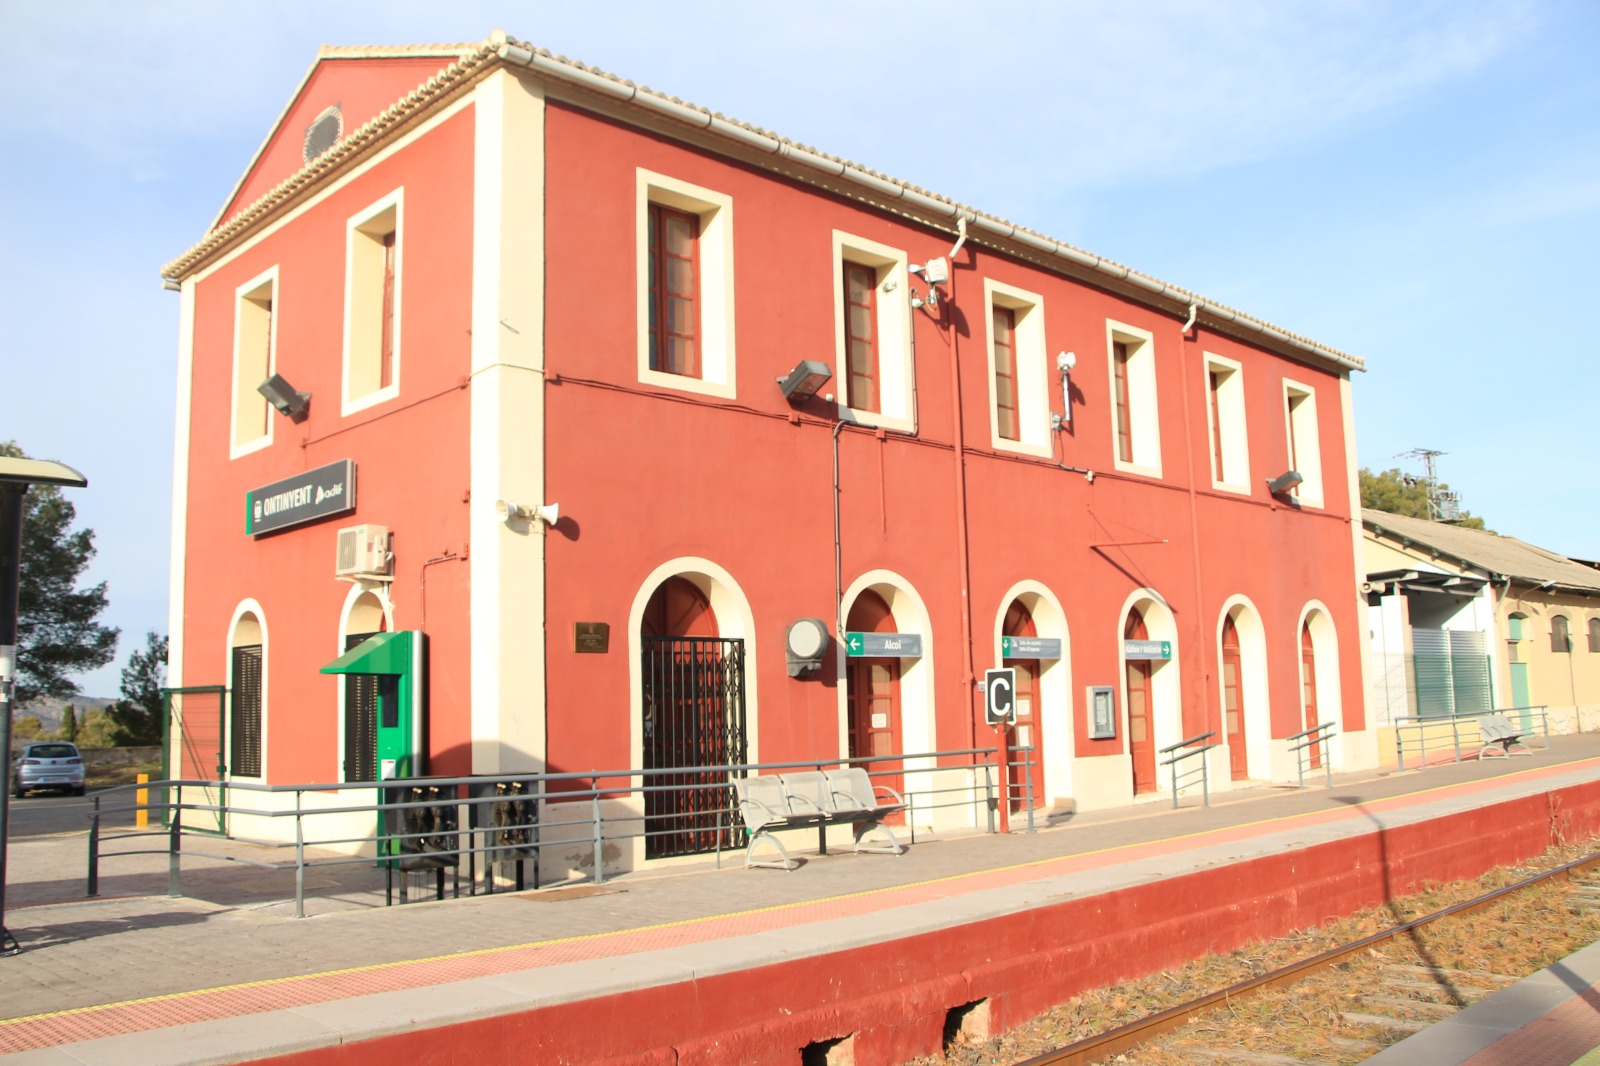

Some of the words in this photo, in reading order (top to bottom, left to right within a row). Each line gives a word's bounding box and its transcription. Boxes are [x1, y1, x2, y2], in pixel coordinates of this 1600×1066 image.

[263, 484, 313, 517] ONTINYENT
[884, 639, 902, 650] Alcoi
[990, 677, 1011, 717] C
